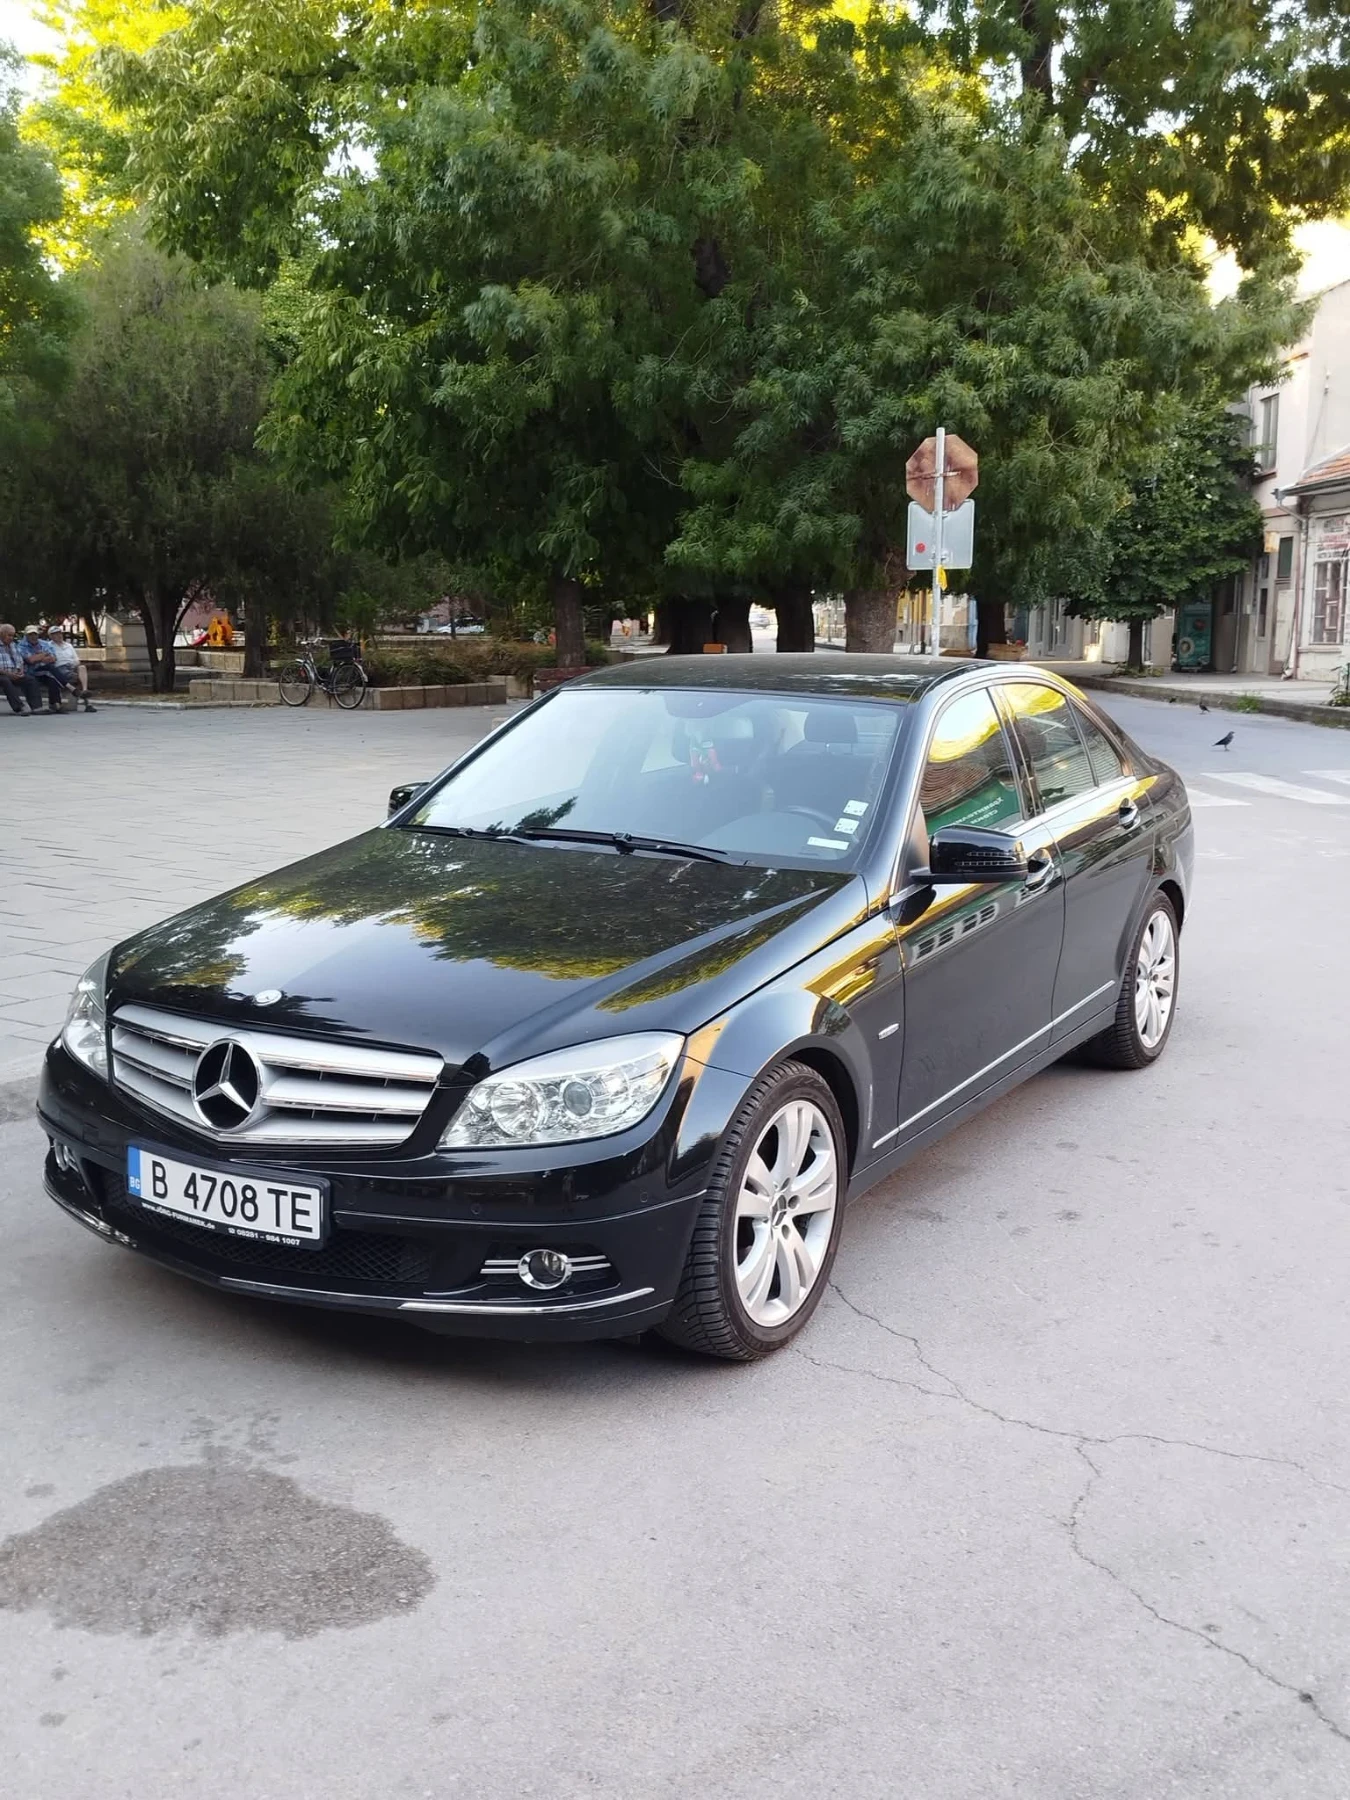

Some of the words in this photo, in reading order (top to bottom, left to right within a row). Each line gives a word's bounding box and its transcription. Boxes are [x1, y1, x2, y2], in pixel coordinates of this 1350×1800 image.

[130, 1176, 140, 1188] BG
[152, 1160, 168, 1199] B
[183, 1172, 259, 1222] 4708
[267, 1188, 313, 1233] TE
[282, 1237, 301, 1246] 1007
